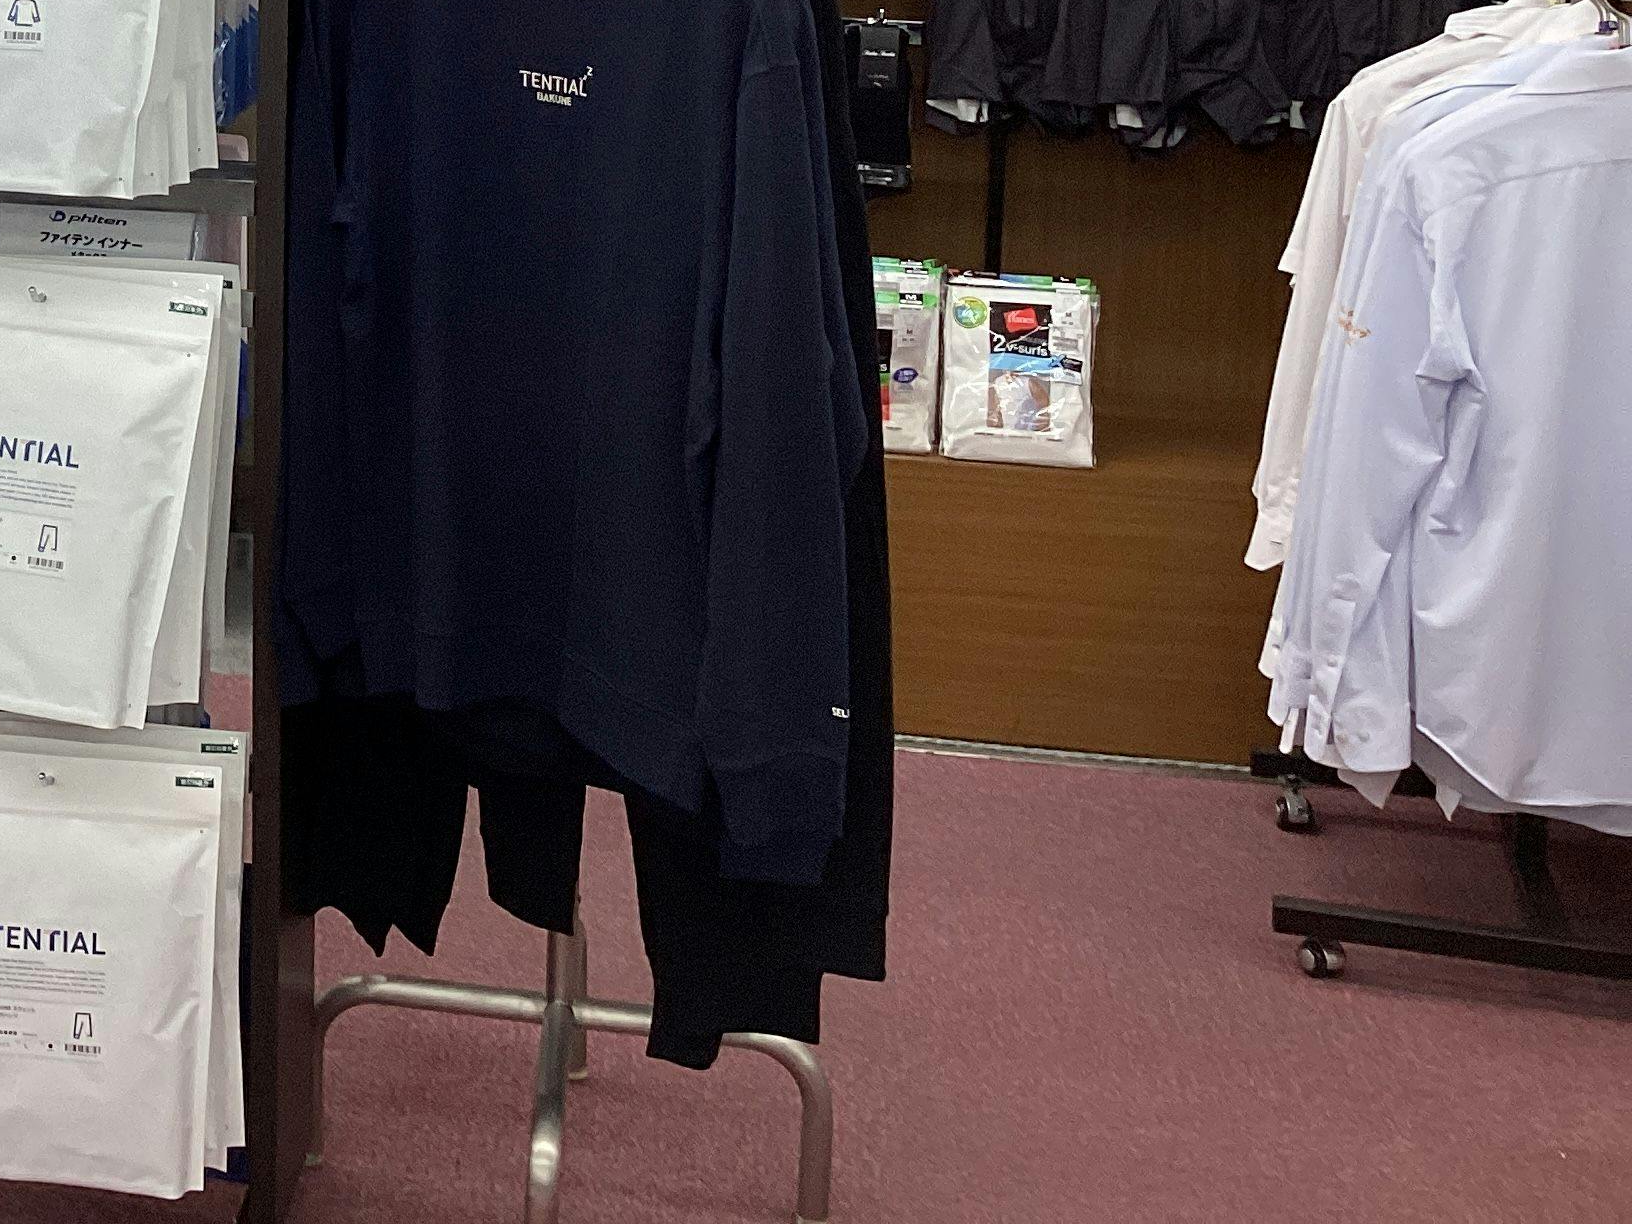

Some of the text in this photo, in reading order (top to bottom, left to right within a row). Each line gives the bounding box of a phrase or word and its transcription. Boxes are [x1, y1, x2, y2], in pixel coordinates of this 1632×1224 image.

[519, 69, 588, 97] TENTIAL
[536, 91, 572, 106] BAKUNE
[39, 230, 143, 251] ファイテン インナー
[993, 334, 1006, 353] 2
